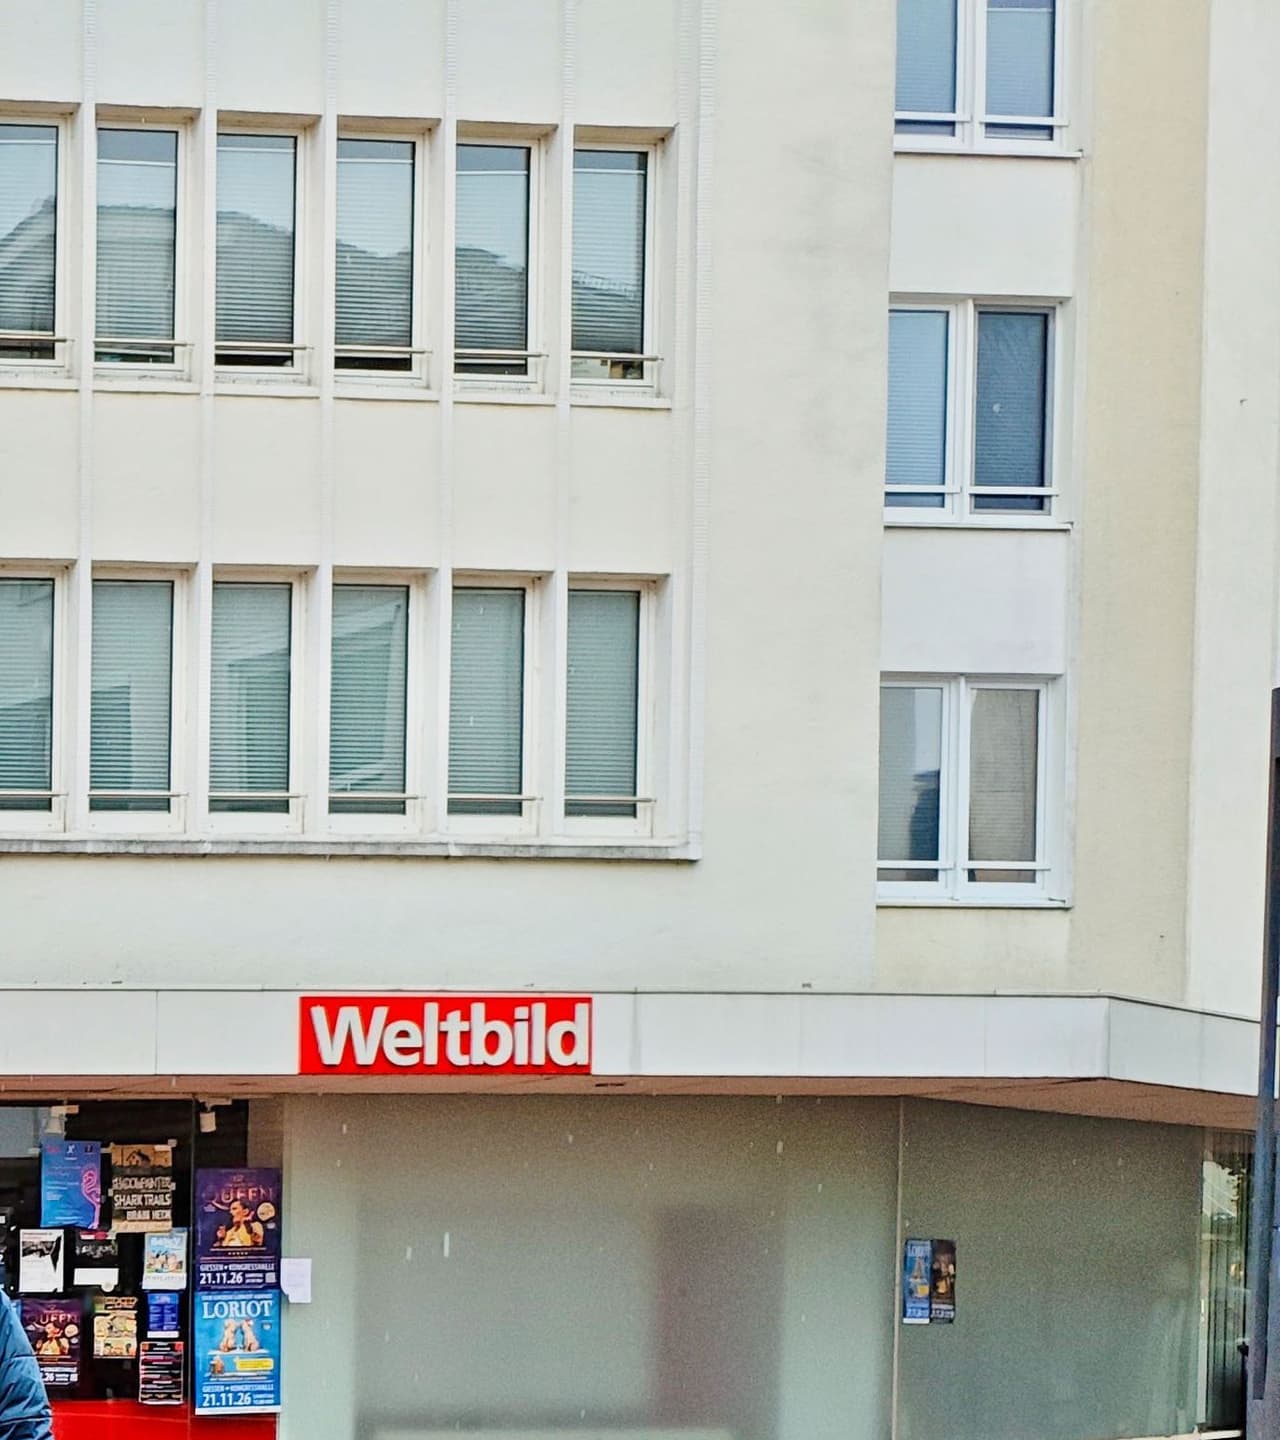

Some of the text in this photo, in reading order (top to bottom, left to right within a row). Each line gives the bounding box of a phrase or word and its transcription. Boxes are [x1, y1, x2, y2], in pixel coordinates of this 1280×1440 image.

[310, 1001, 590, 1067] Weltbild
[113, 1193, 172, 1206] SHARK TRAILS
[200, 1272, 244, 1285] 21.11.26
[202, 1300, 273, 1319] LORIOT
[202, 1392, 252, 1407] 21.11.26
